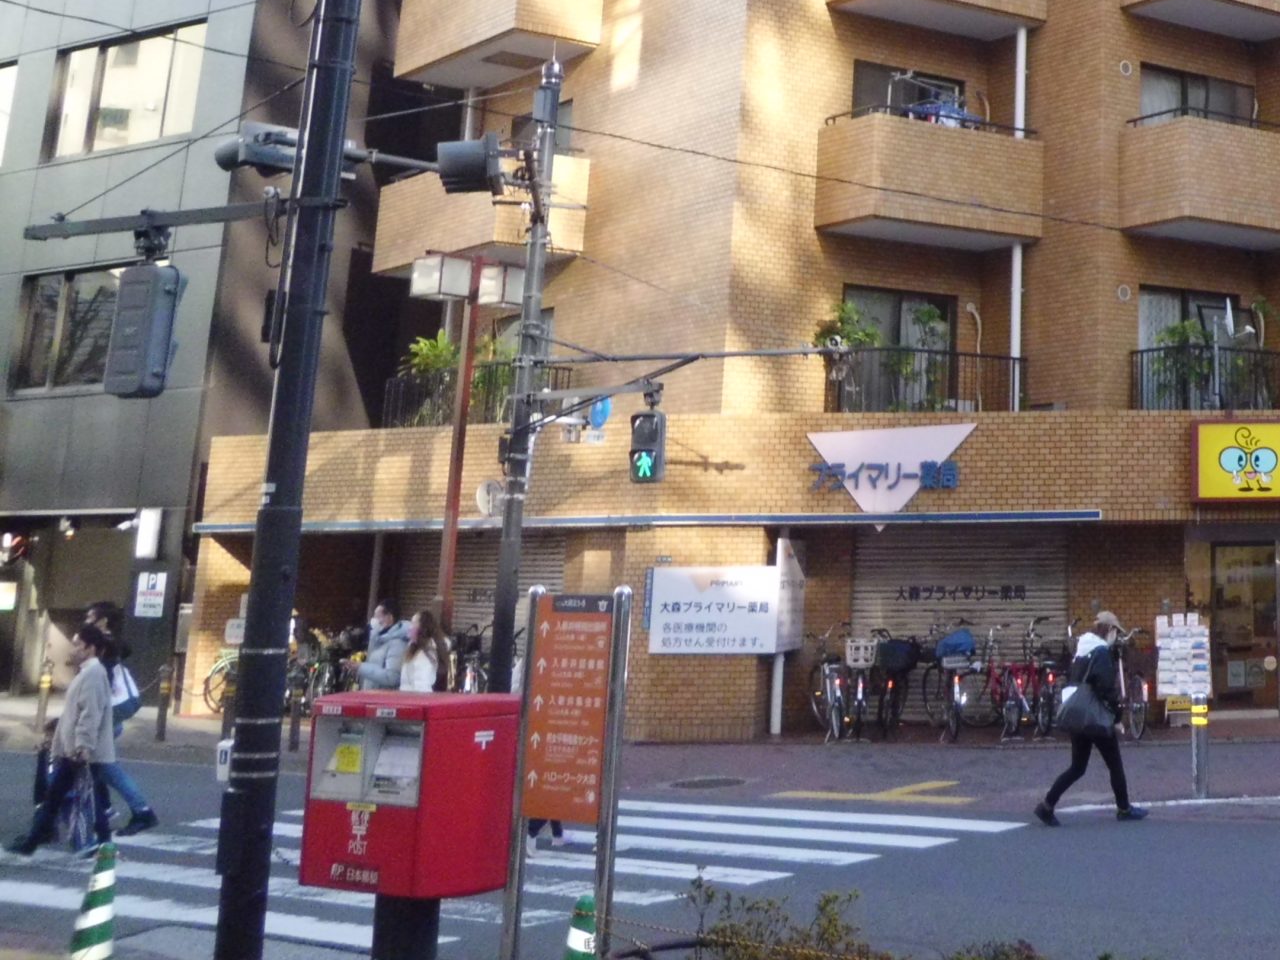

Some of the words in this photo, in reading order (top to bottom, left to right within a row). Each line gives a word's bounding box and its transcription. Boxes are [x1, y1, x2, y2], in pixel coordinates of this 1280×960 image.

[809, 461, 959, 491] プライマリー薬局
[659, 601, 769, 614] 大森プライマリー薬局
[662, 622, 728, 633] 各医療機関の
[661, 636, 765, 649] 処方せん受付けます。
[347, 840, 368, 855] POST
